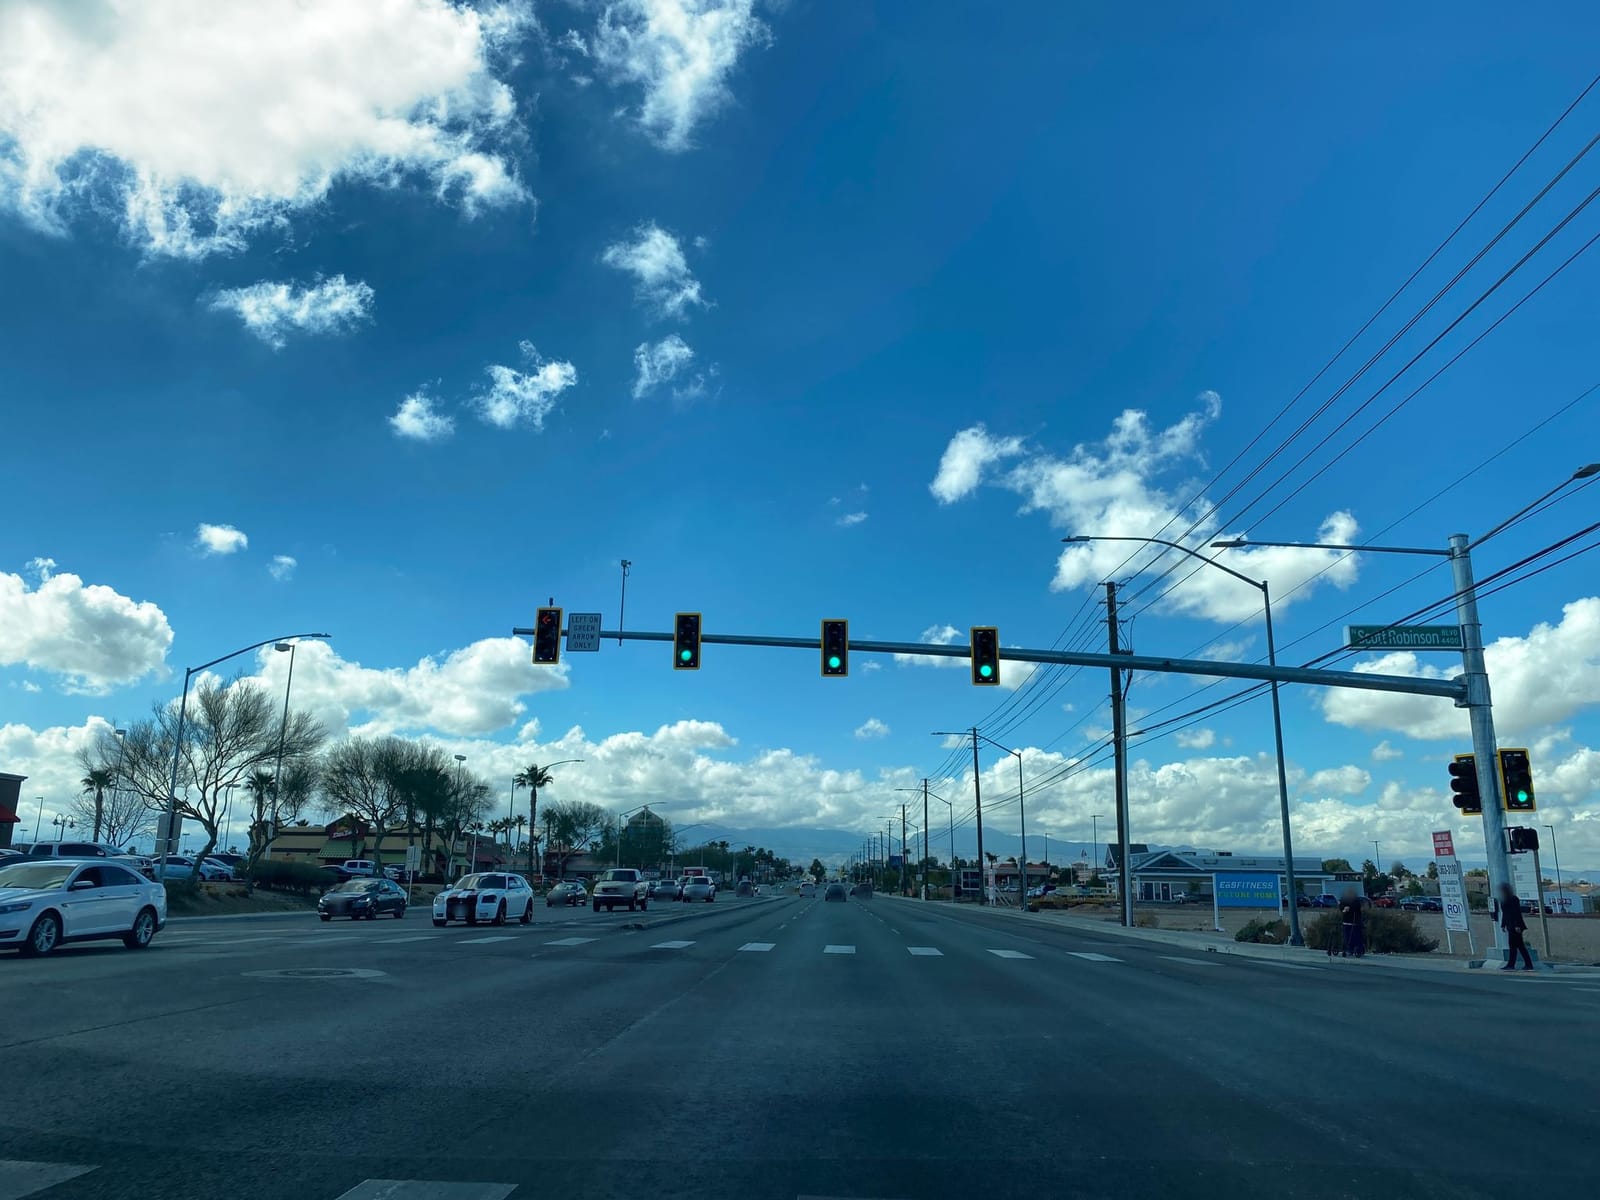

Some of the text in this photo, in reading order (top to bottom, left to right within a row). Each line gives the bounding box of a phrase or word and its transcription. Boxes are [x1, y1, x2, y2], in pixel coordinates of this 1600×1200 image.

[1357, 629, 1388, 644] Scott
[1388, 629, 1440, 644] Robinson
[1441, 629, 1458, 637] BLVD
